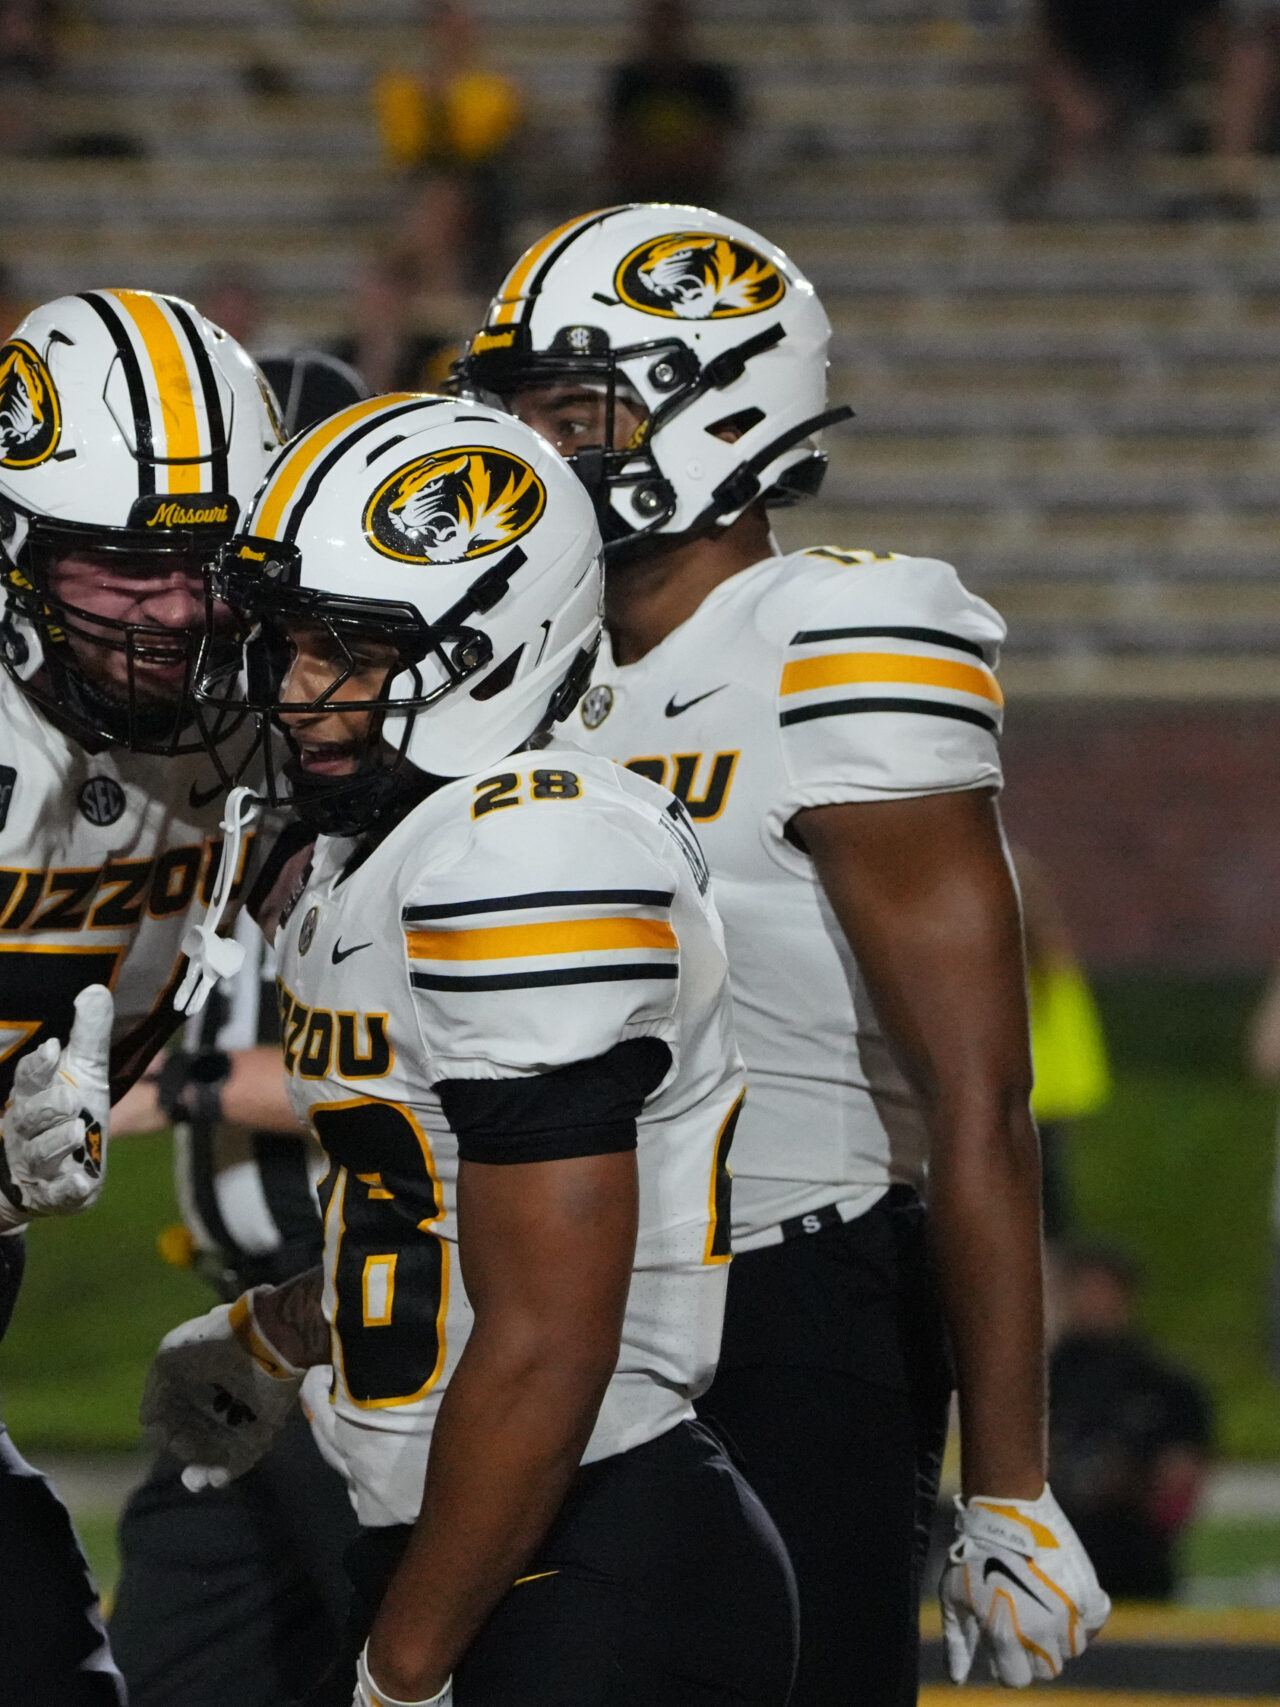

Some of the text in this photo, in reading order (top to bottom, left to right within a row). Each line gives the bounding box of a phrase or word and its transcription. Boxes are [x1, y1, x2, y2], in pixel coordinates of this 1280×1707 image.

[146, 503, 229, 527] Missouri
[81, 778, 122, 825] SEC
[471, 768, 584, 822] 28
[802, 1214, 822, 1234] S
